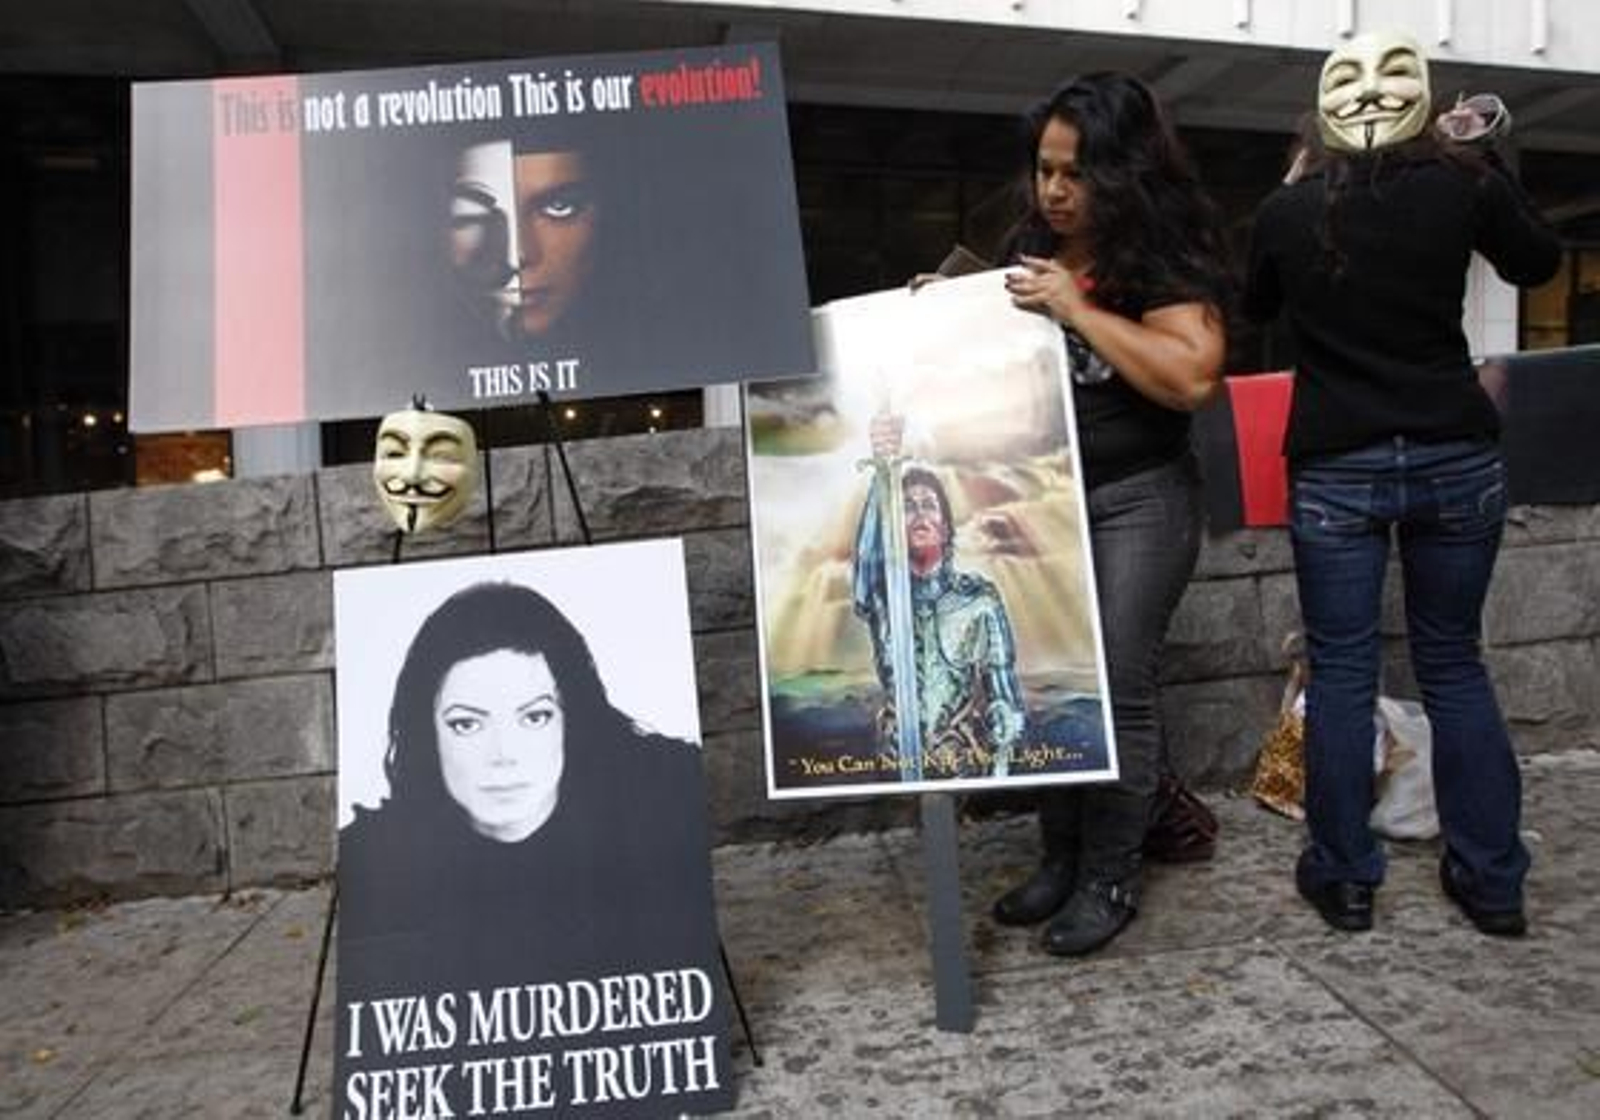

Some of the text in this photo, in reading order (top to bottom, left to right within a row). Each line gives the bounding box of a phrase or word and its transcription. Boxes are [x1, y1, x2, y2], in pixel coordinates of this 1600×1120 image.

[303, 90, 347, 131] not
[354, 92, 370, 128] a
[377, 78, 502, 126] revolution
[507, 72, 559, 117] This
[564, 69, 586, 113] is
[591, 75, 633, 111] our
[639, 58, 762, 108] evolution!
[468, 358, 580, 398] THIS IS IT
[838, 754, 875, 772] Can
[345, 967, 713, 1058] I WAS MURDERED
[344, 1035, 721, 1120] SEEK THE TRUTH
